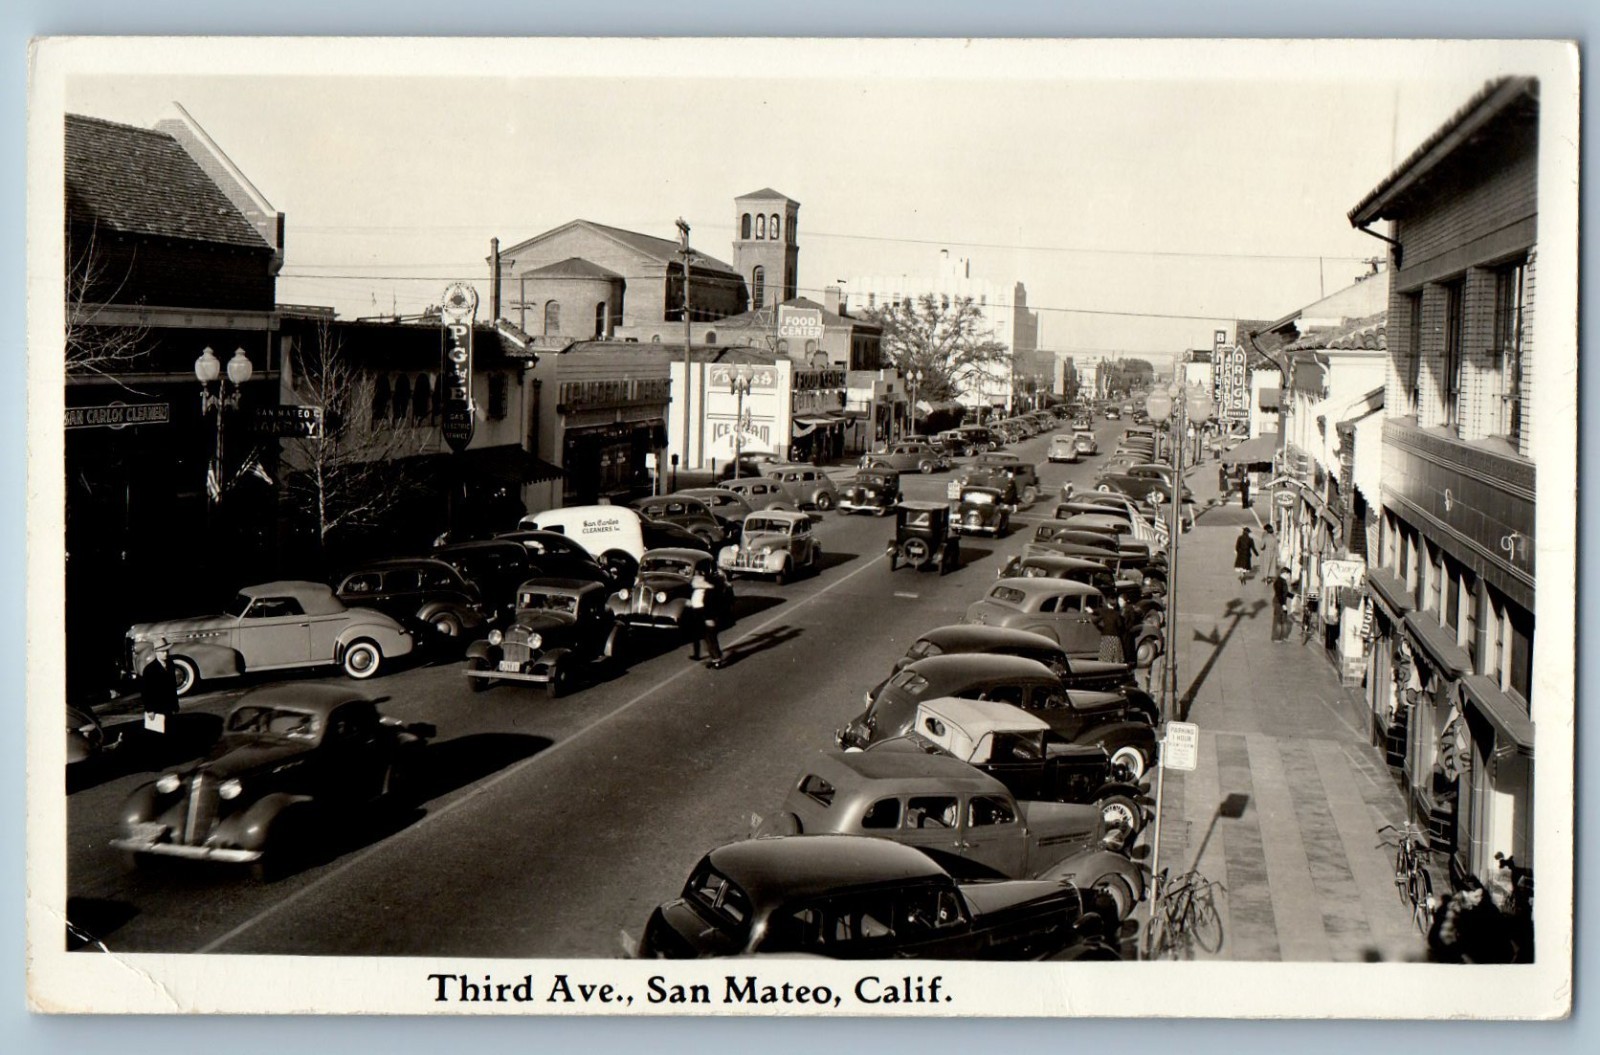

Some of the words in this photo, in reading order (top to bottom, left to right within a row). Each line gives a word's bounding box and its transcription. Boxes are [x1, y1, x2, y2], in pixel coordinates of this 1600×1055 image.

[785, 316, 816, 326] FOOD
[780, 326, 821, 337] CENTER
[797, 371, 820, 388] FOOD
[1233, 354, 1243, 408] DRUGS
[86, 408, 123, 424] CARLOS
[278, 409, 309, 418] MATEO
[713, 423, 730, 442] ICE
[582, 526, 613, 534] CLEANERS
[1170, 727, 1194, 735] PARKING
